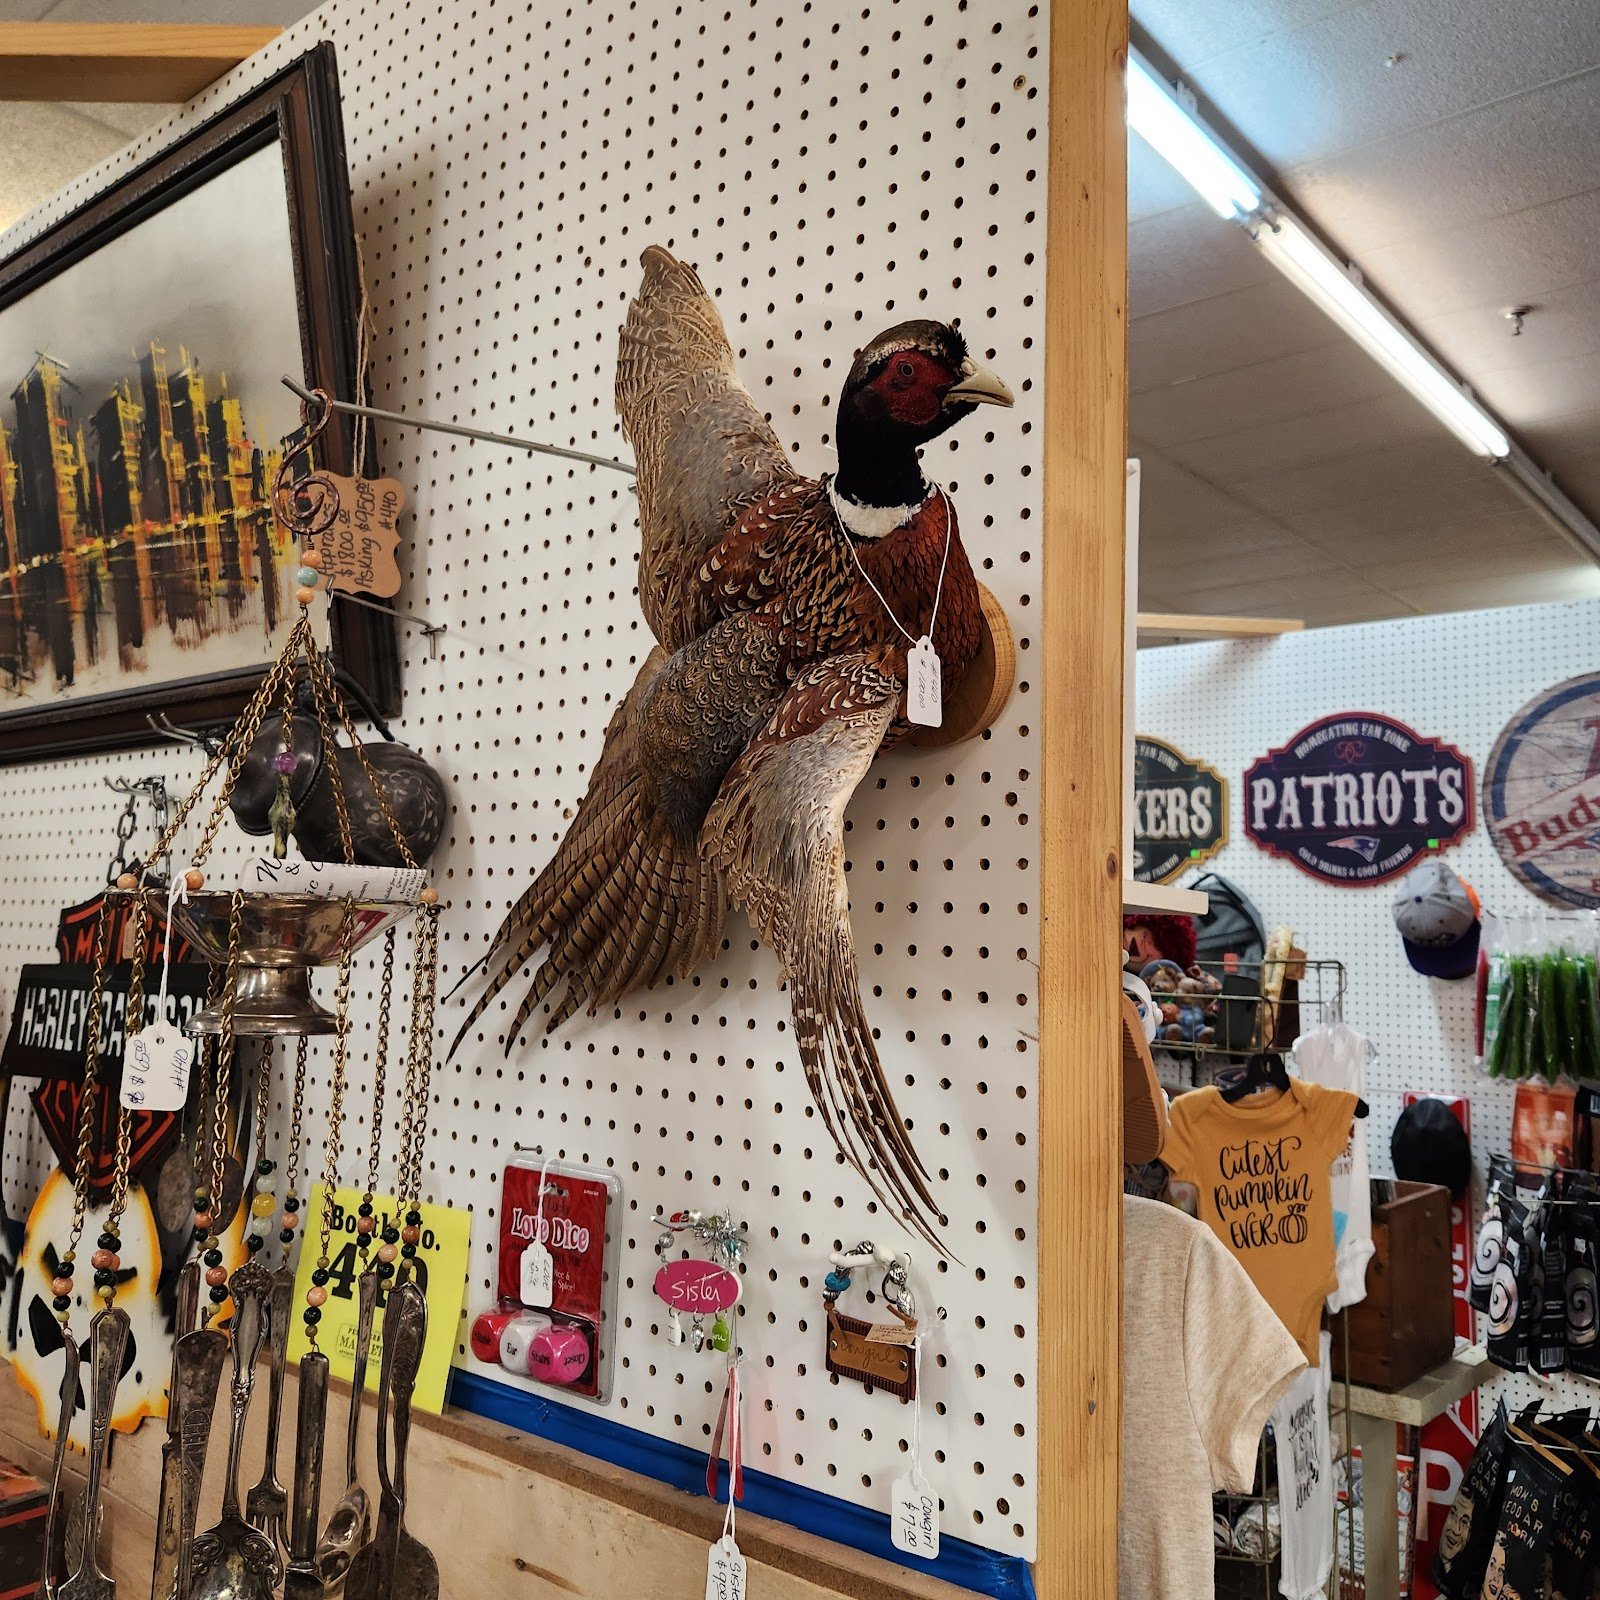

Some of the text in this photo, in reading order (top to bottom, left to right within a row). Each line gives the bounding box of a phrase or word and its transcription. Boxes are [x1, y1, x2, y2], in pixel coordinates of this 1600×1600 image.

[378, 491, 398, 531] #440
[354, 537, 382, 589] Asking
[1361, 722, 1382, 739] FAN
[1383, 727, 1412, 753] ZONE
[1158, 750, 1179, 772] ZONE
[1251, 766, 1465, 830] PATRIOTS
[1298, 847, 1318, 866] COLD
[1318, 861, 1348, 877] DRINKS
[1357, 863, 1378, 878] GOOD
[1380, 843, 1414, 870] FRIENDS
[18, 986, 90, 1052] HARLEY
[1219, 1135, 1302, 1180] Cutest
[511, 1207, 590, 1253] Love Dice
[1230, 1212, 1279, 1249] EVER
